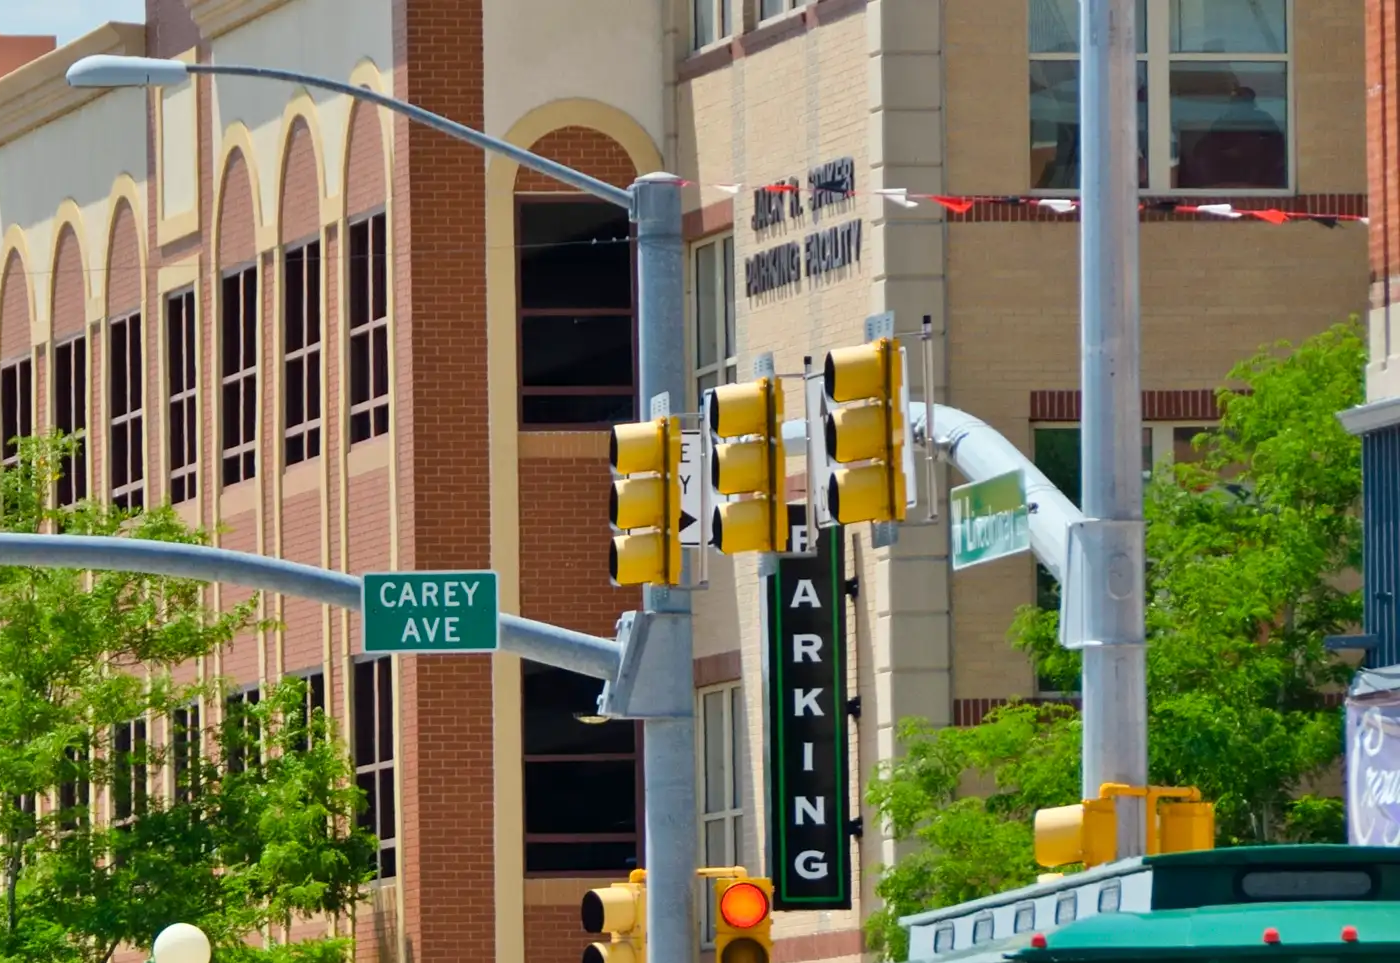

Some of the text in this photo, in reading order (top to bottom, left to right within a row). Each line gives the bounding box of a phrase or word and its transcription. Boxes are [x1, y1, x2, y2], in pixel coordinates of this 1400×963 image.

[745, 218, 861, 297] PARKING FACILITY
[380, 581, 480, 608] CAREY
[401, 617, 461, 643] AVE
